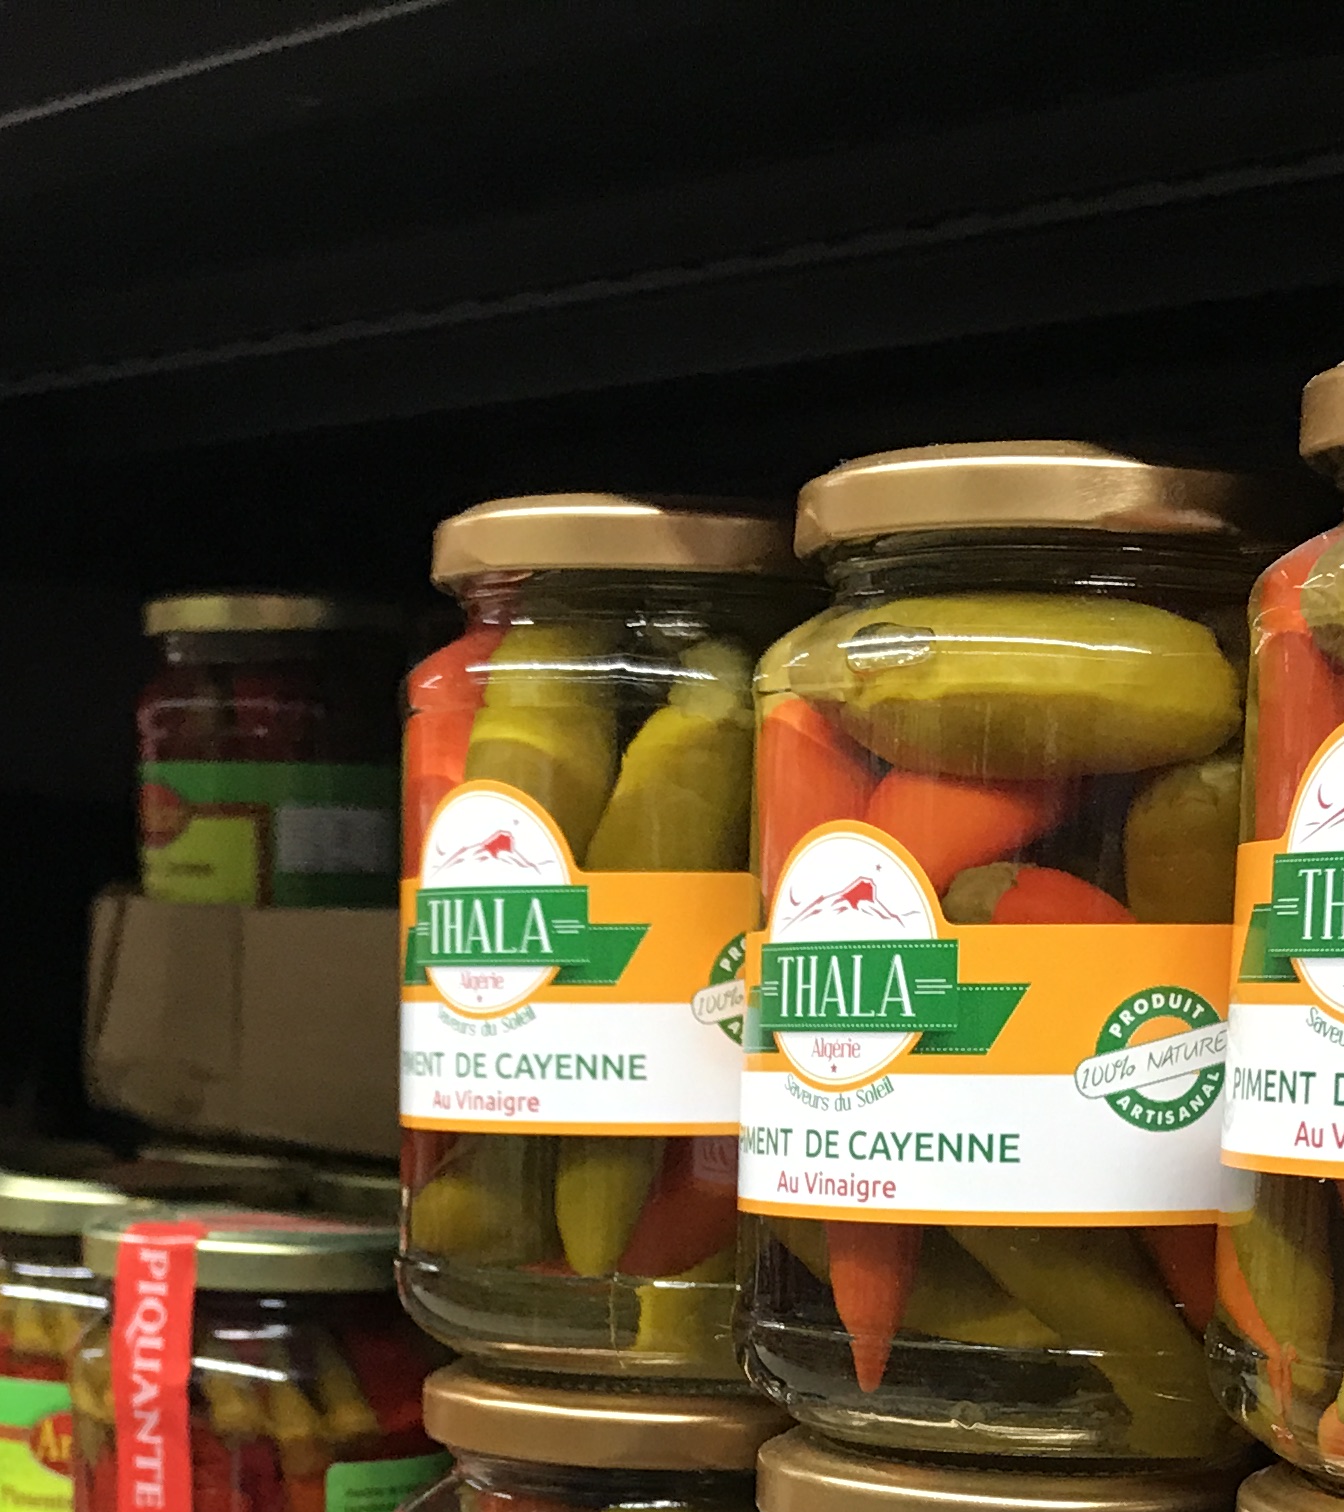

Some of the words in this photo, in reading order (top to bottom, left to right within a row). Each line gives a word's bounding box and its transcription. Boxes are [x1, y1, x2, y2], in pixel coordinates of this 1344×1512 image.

[428, 897, 553, 955] THALA
[698, 986, 744, 1016] 100%
[777, 953, 916, 1019] THALA
[481, 1020, 498, 1037] du
[503, 1004, 537, 1033] Soleil
[1109, 992, 1204, 1038] PRODUIT
[455, 1052, 488, 1079] DE
[494, 1053, 647, 1081] CAYENNE
[811, 1037, 861, 1064] Algérie
[1081, 1055, 1136, 1090] 100%
[1233, 1070, 1316, 1106] PIMENT
[433, 1090, 451, 1110] Au
[455, 1090, 540, 1117] Vinaigre
[784, 1073, 829, 1112] Saveurs
[834, 1093, 852, 1112] du
[855, 1075, 895, 1108] Soleil
[1116, 1070, 1220, 1125] ARTISANAL
[805, 1129, 840, 1159] DE
[848, 1130, 1021, 1163] CAYENNE
[1294, 1121, 1325, 1149] Au
[776, 1170, 799, 1193] Au
[804, 1171, 897, 1203] Vinaigre
[125, 1248, 170, 1510] PIQUANTE
